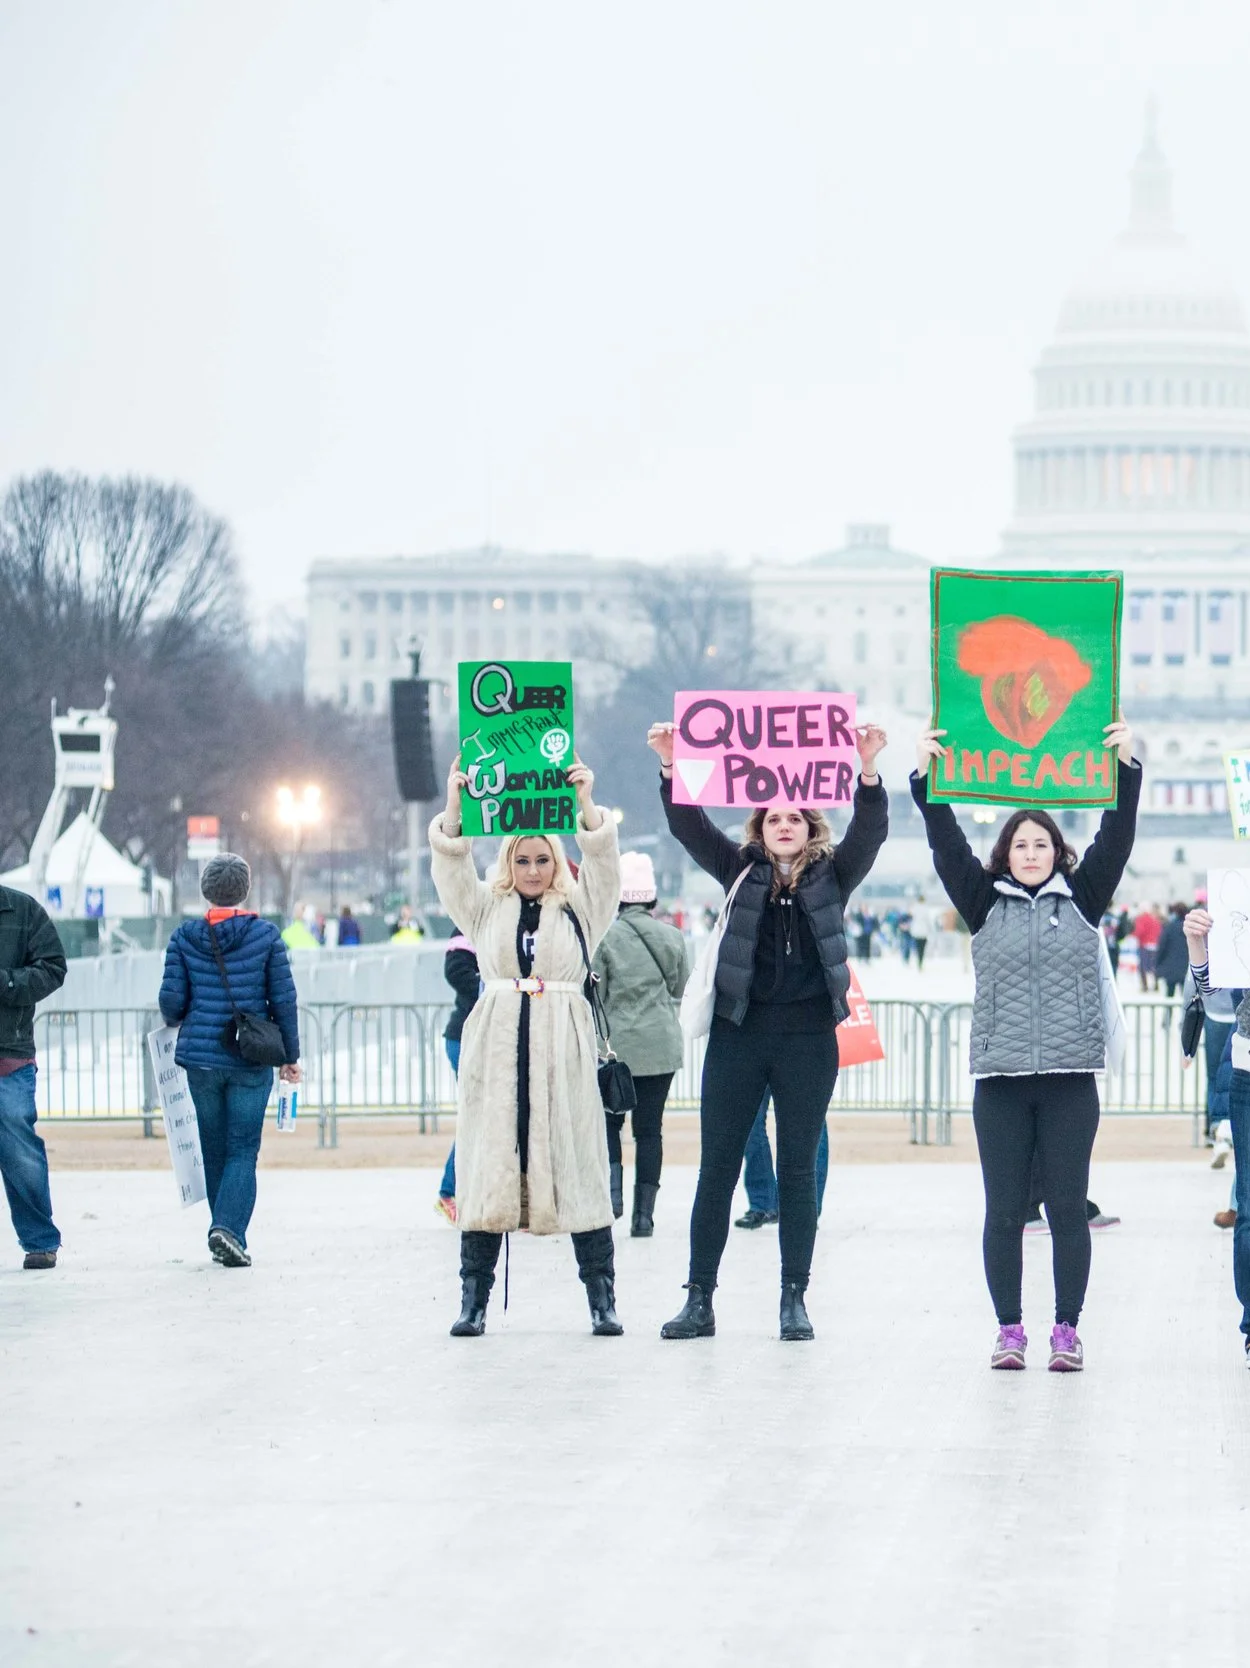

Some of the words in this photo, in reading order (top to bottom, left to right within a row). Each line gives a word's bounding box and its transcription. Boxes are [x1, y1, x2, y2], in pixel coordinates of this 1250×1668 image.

[679, 698, 855, 750] QUEER
[723, 754, 854, 804] POWER
[943, 746, 1111, 789] IMPEACH
[480, 796, 575, 834] POWER
